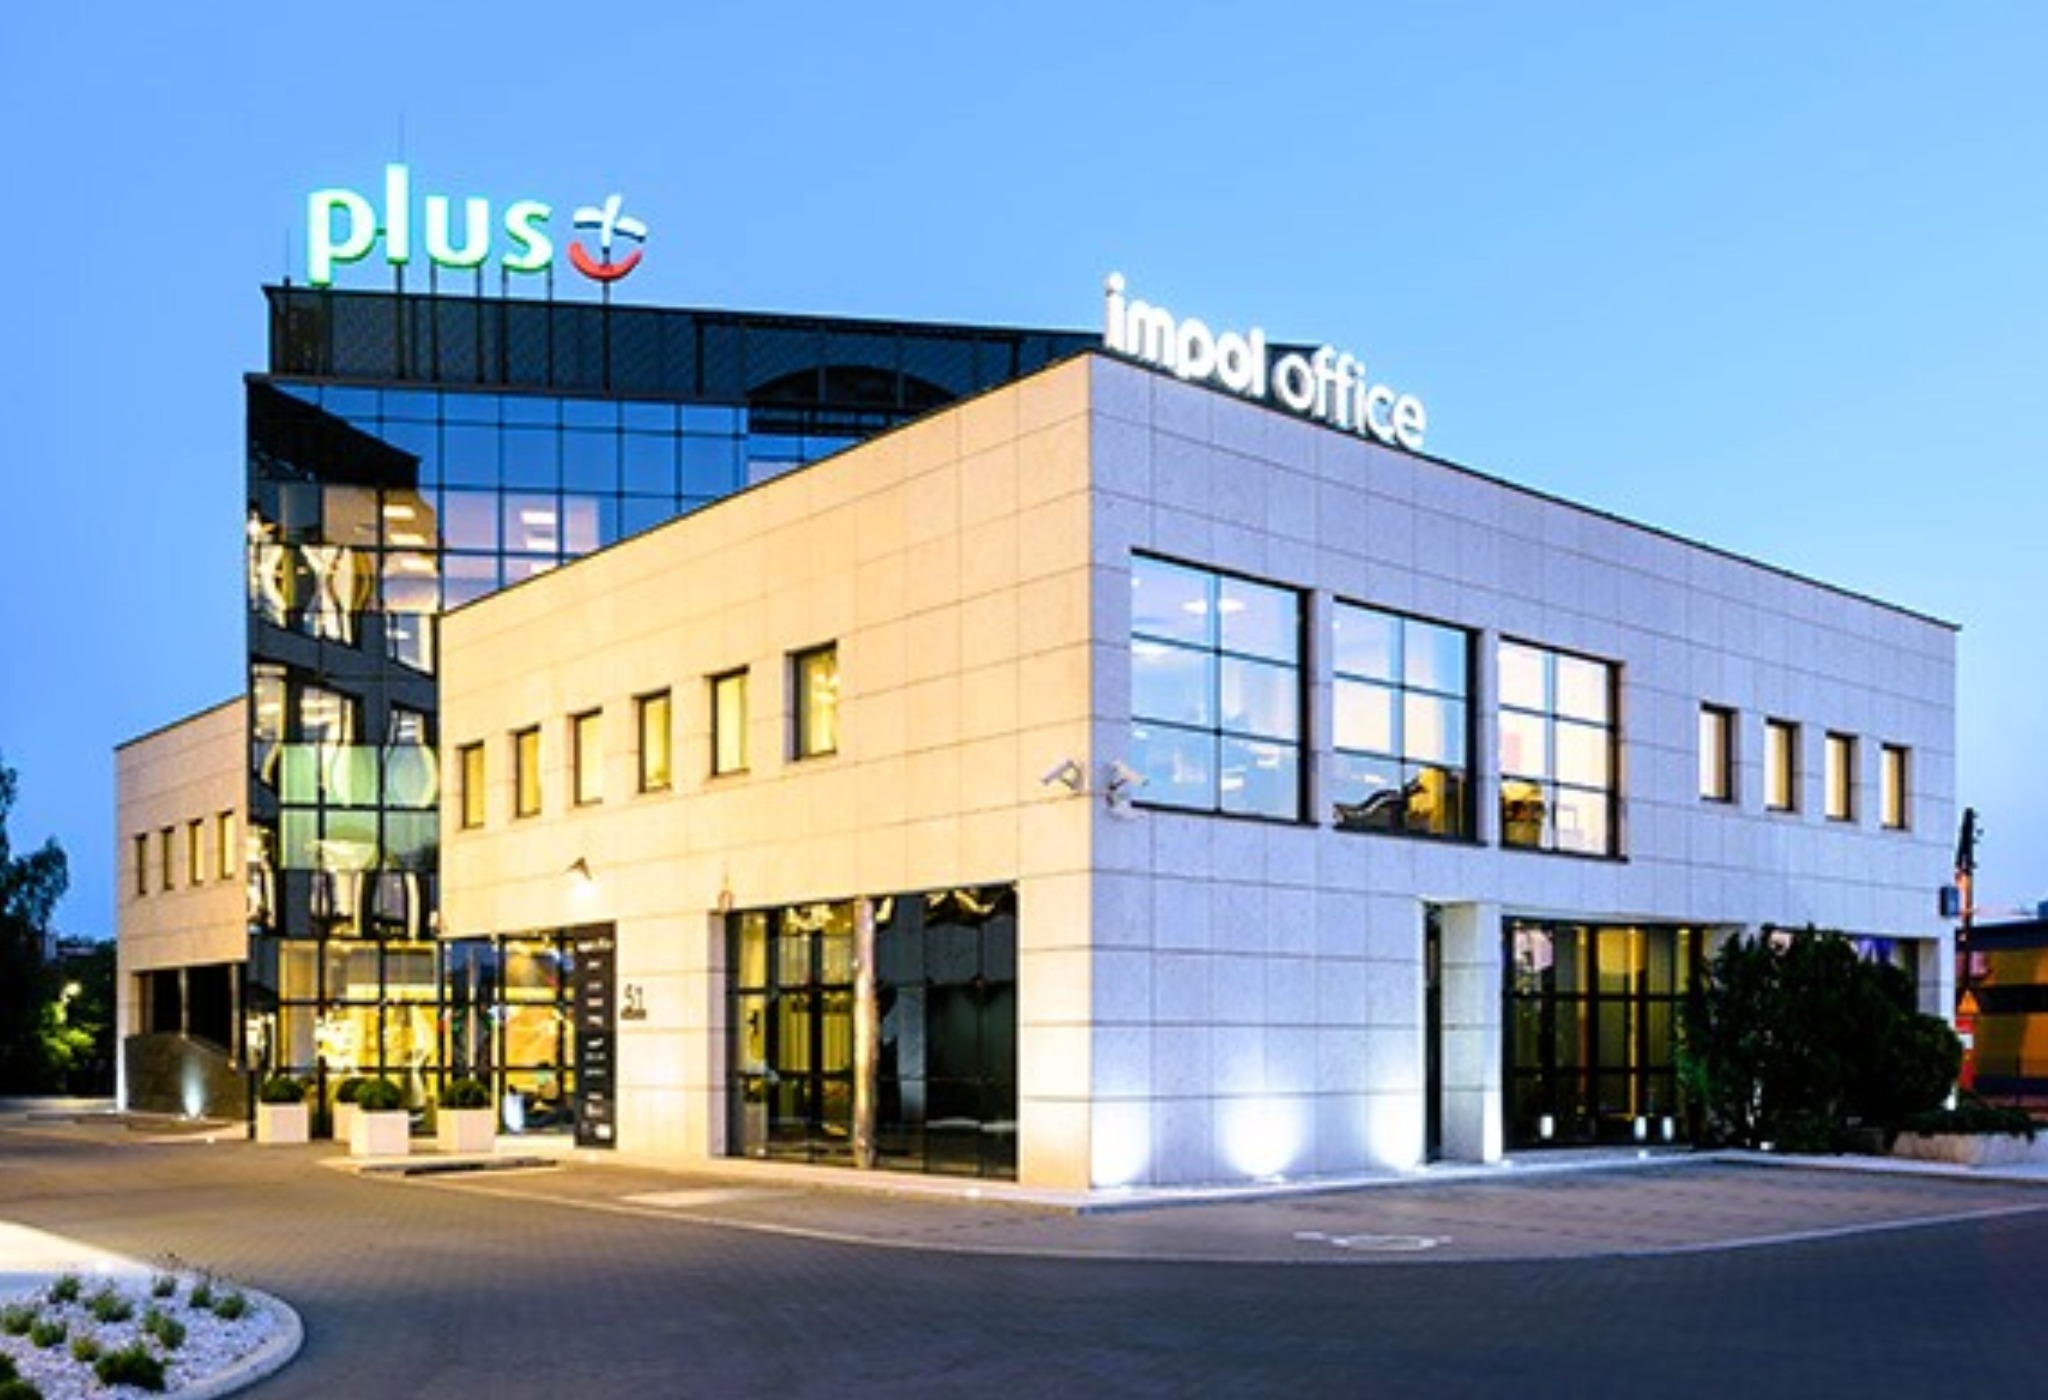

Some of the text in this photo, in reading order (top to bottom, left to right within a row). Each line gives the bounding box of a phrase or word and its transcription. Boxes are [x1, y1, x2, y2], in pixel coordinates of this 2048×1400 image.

[307, 163, 552, 287] plus
[1105, 271, 1425, 450] impol office
